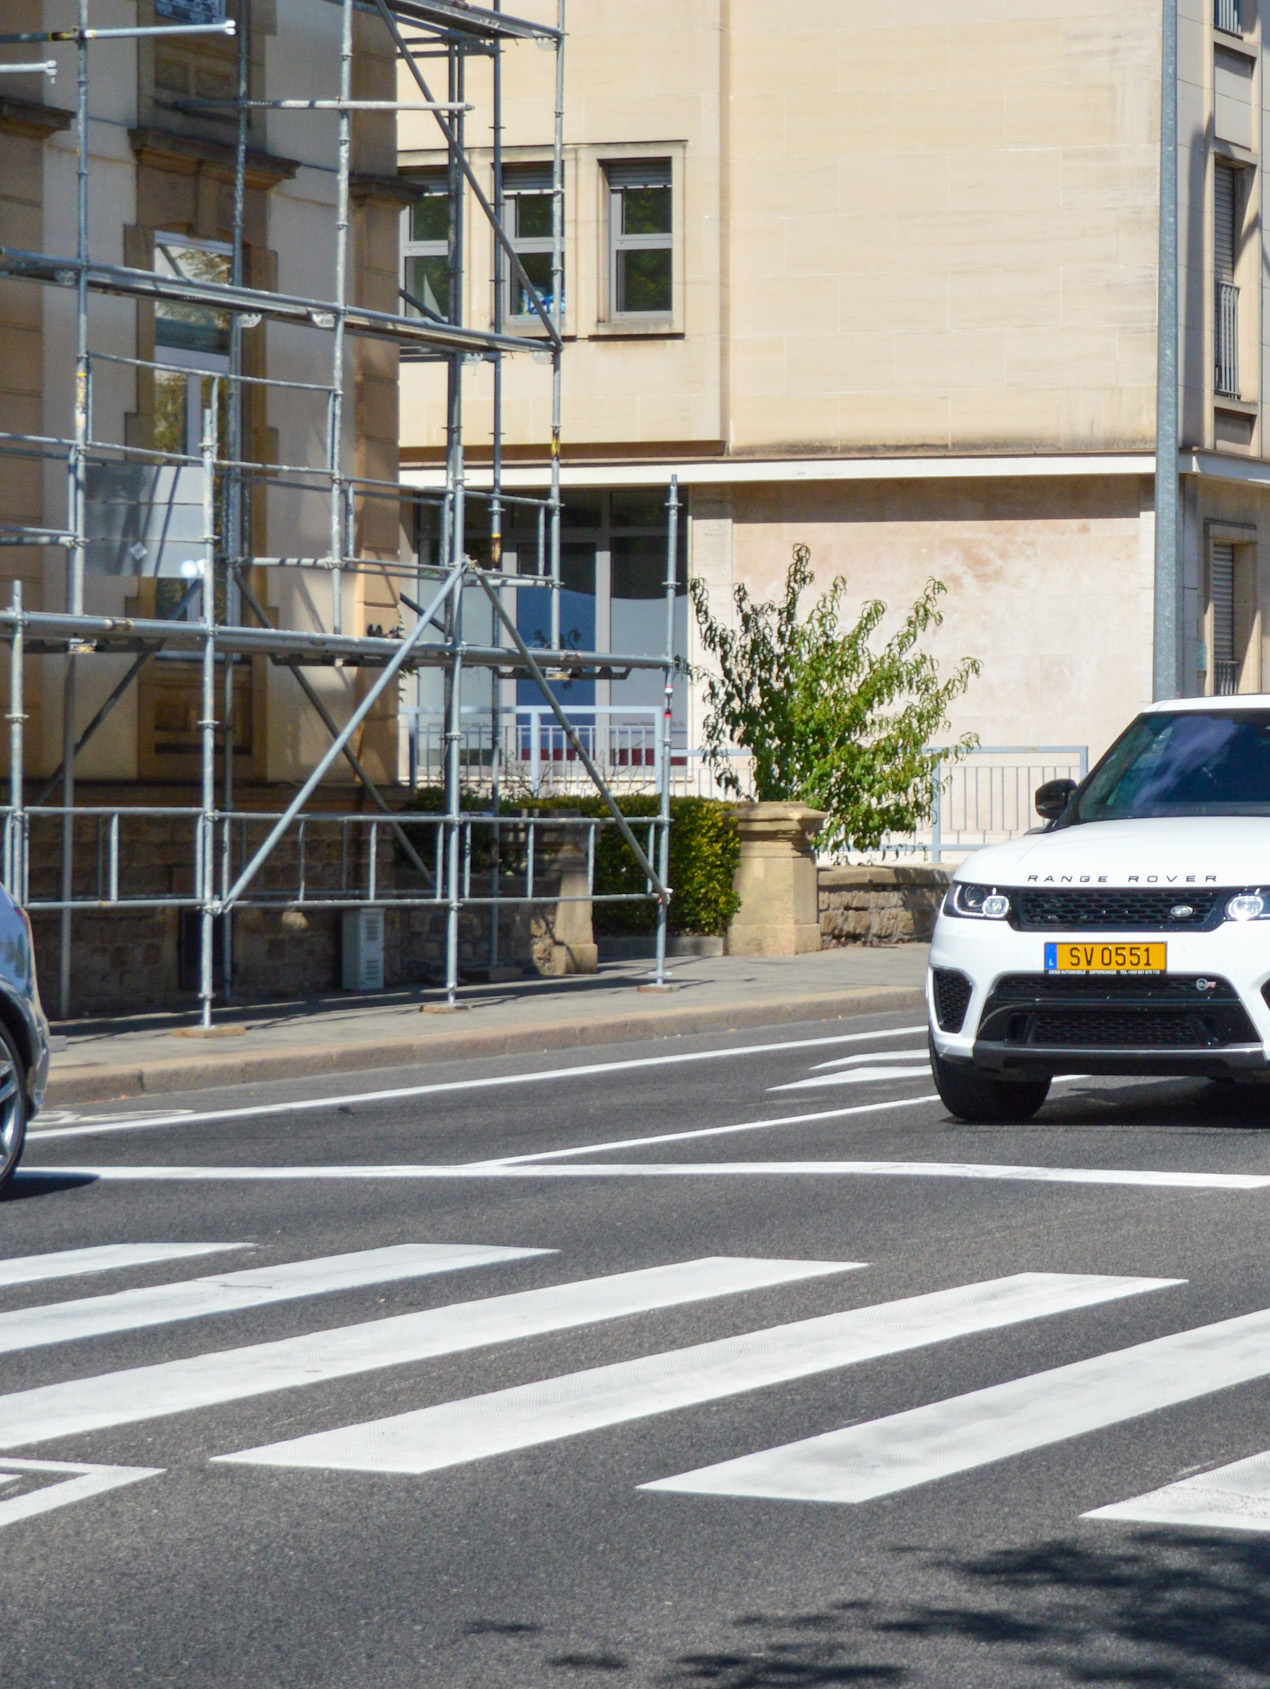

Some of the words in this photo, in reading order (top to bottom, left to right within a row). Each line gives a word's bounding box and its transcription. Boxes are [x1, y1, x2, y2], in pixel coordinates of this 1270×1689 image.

[1027, 875, 1109, 883] RANGE
[1128, 875, 1217, 883] ROVER
[1069, 946, 1094, 967] SV
[1101, 946, 1152, 967] 0551
[1049, 958, 1054, 966] L
